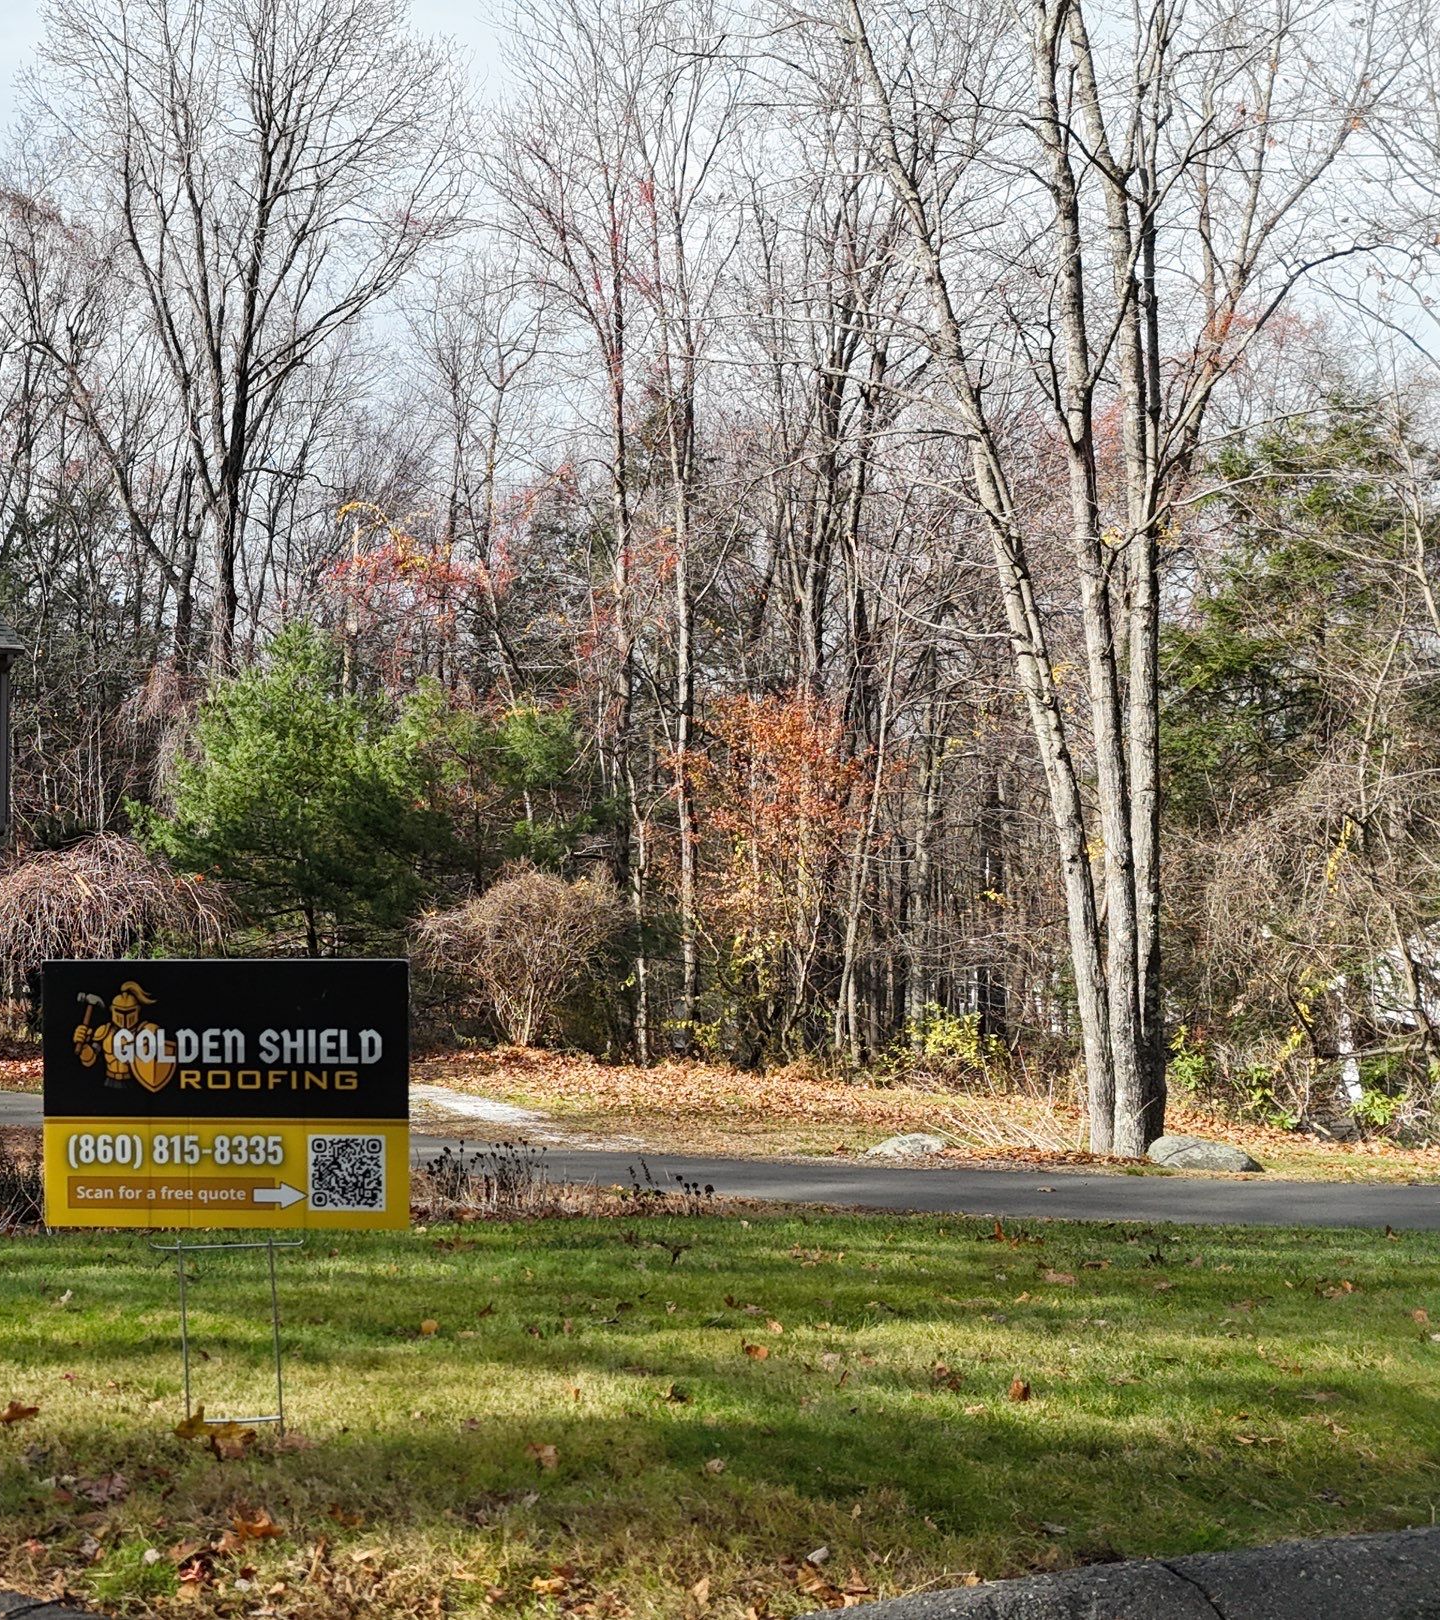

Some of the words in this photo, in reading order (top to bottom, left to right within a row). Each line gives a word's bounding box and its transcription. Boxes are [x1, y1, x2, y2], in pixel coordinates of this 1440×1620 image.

[113, 1028, 245, 1064] GOLDEN
[259, 1028, 383, 1065] SHIELD
[180, 1070, 358, 1090] ROOFING
[68, 1134, 143, 1169] (860)
[153, 1135, 284, 1165] 815-8335
[76, 1186, 114, 1200] Scan
[119, 1186, 142, 1200] for
[146, 1189, 156, 1200] a
[161, 1186, 193, 1200] free
[198, 1187, 246, 1203] quote
